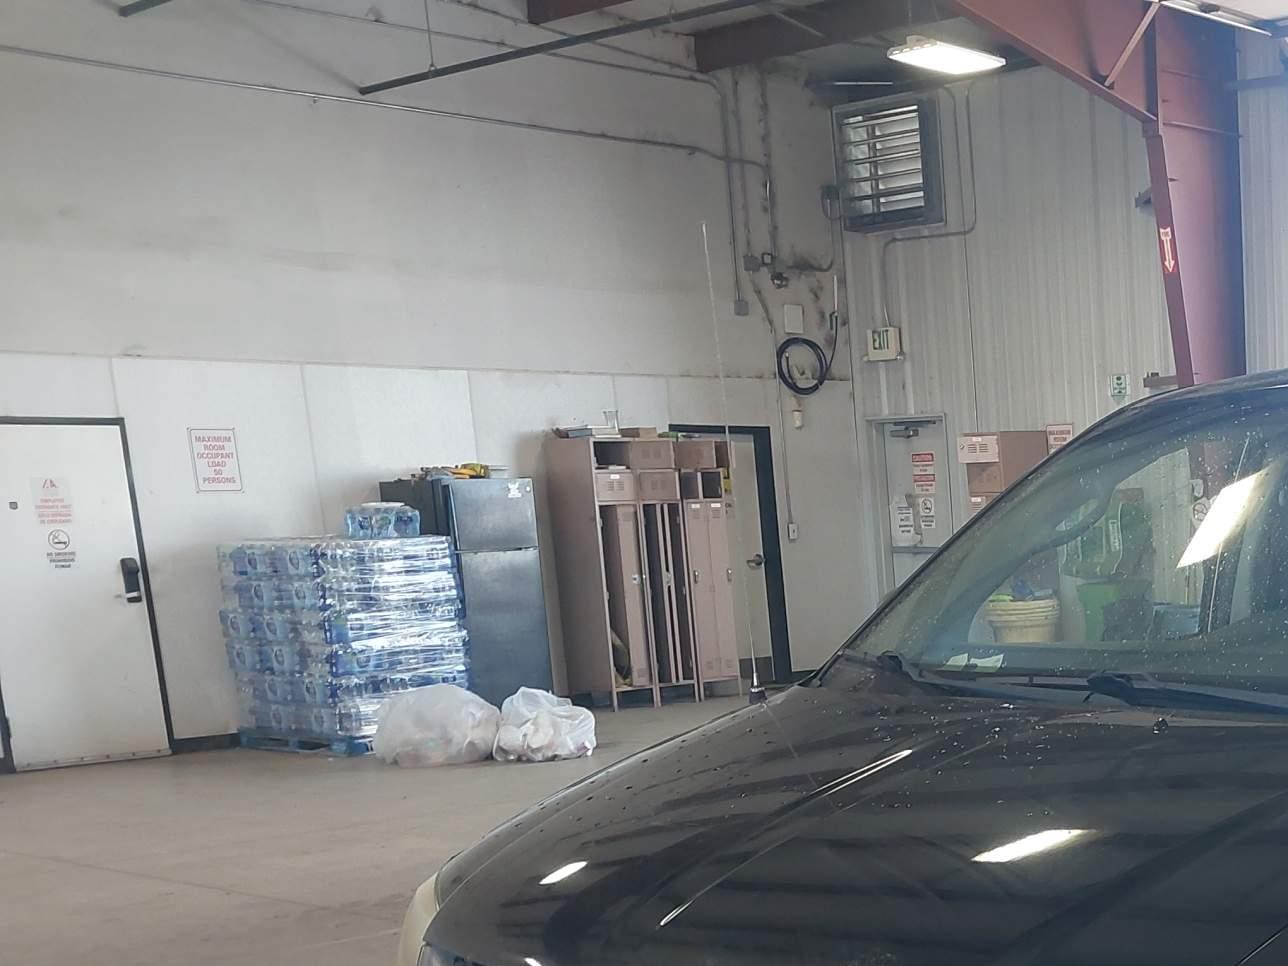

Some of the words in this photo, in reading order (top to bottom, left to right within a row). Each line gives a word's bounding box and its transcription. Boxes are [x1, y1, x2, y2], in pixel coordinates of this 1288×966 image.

[872, 329, 889, 351] EXIT
[195, 435, 232, 443] MAXIMUM
[203, 443, 225, 451] ROOM
[196, 451, 234, 459] OCCUPANT
[207, 460, 227, 468] LOAD
[202, 476, 236, 484] PERSONS
